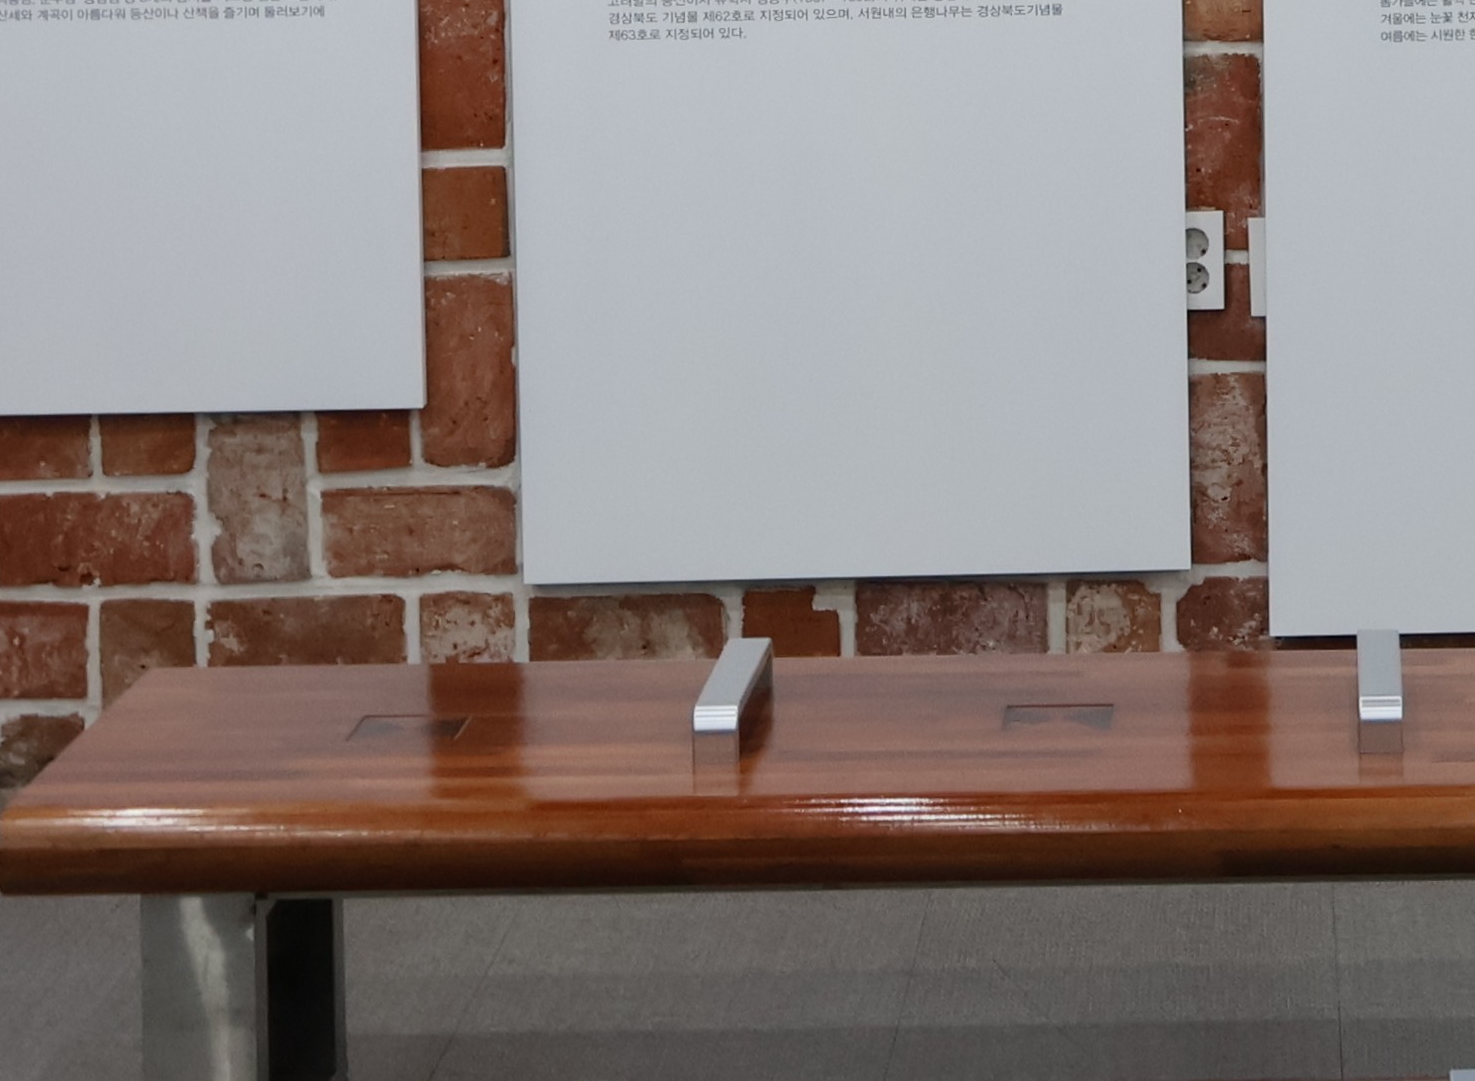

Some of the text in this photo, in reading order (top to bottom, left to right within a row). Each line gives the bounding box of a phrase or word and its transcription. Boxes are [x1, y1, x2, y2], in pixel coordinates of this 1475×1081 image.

[608, 11, 658, 26] 경상북도
[662, 10, 699, 24] 기념물
[702, 9, 756, 23] 제62호로
[759, 8, 809, 22] 지정되어
[857, 6, 908, 20] 서원내의
[910, 5, 973, 19] 은행나무는
[976, 3, 1063, 18] 경상북도기념물
[608, 26, 747, 41] 제63호로 지정되어 있다.
